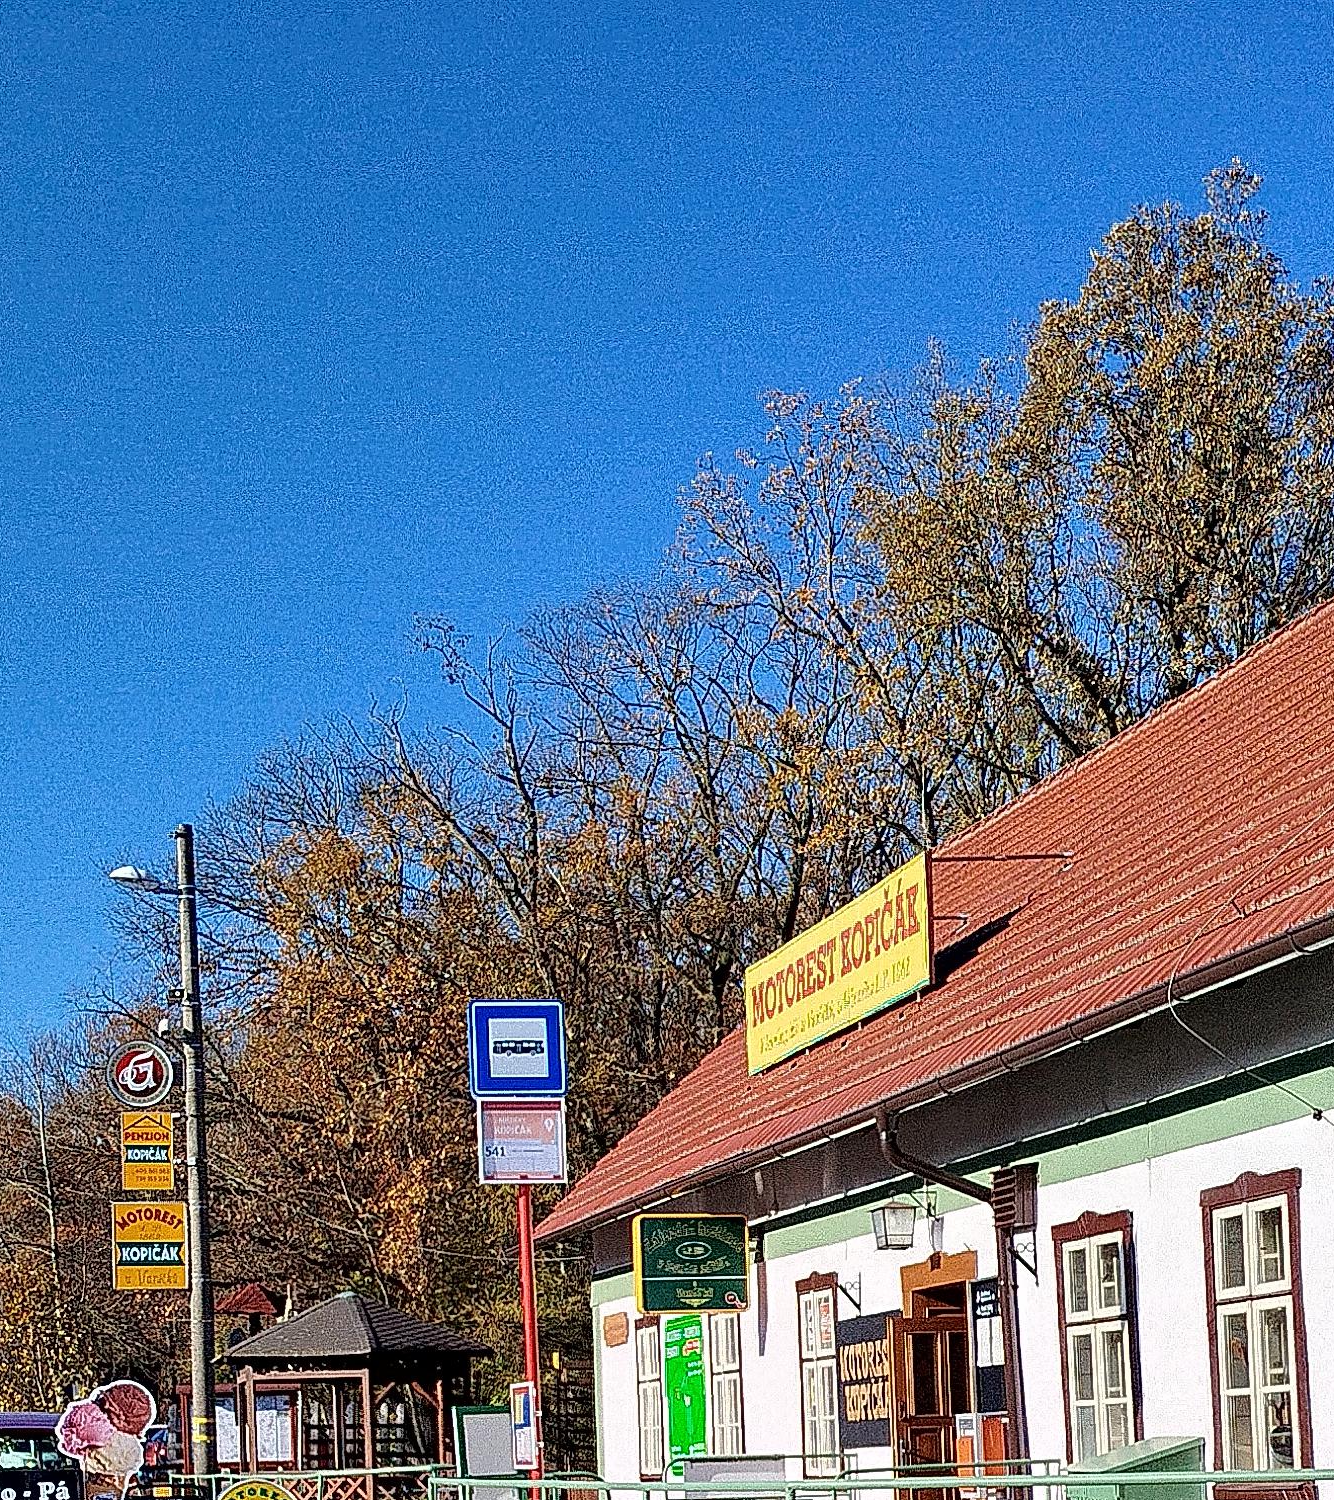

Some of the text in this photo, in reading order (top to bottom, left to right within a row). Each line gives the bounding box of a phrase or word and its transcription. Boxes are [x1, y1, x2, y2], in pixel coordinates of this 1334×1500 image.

[750, 878, 921, 1028] MOTOREST KOPIČÁK
[124, 1131, 170, 1141] PENZION
[127, 1146, 168, 1161] KOPIČÁK
[485, 1145, 506, 1158] 541
[116, 1207, 183, 1231] MOTOREST
[121, 1243, 180, 1261] KOPIČÁK
[839, 1338, 889, 1382] MOTORES
[36, 1480, 70, 1500] Pá
